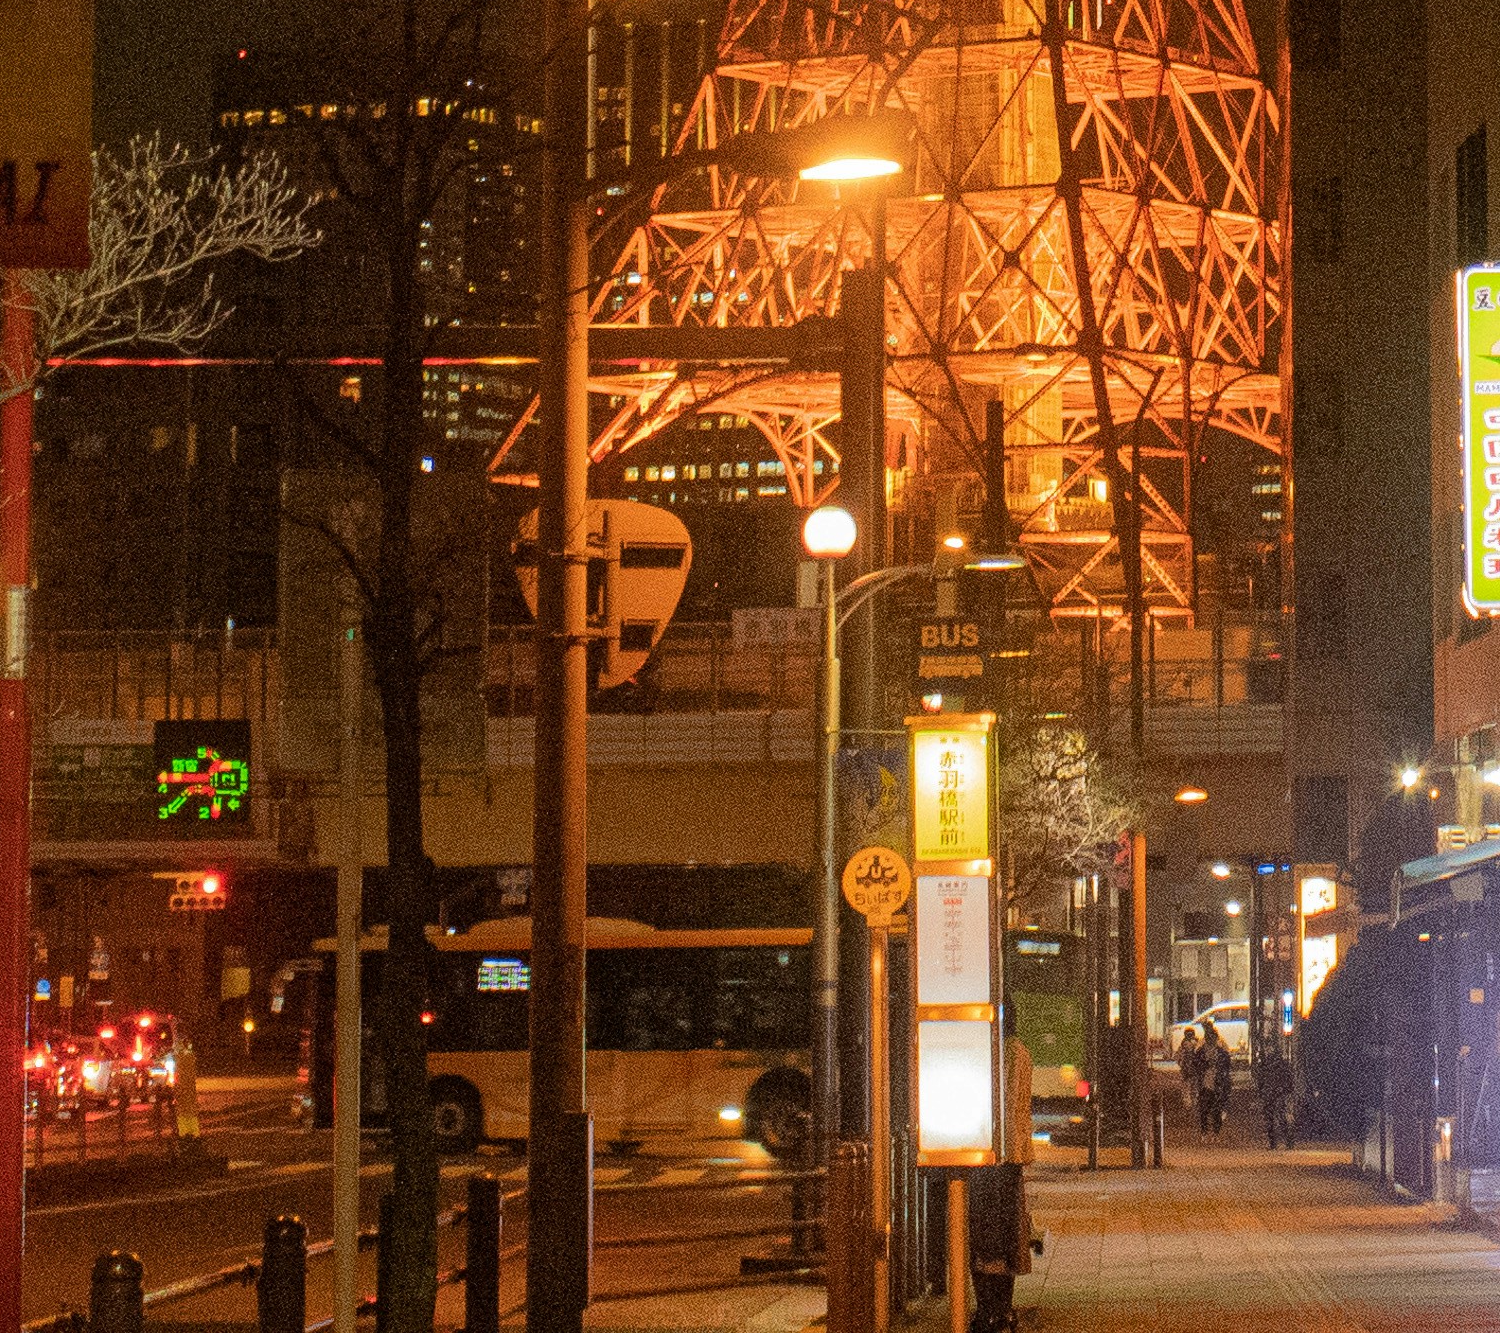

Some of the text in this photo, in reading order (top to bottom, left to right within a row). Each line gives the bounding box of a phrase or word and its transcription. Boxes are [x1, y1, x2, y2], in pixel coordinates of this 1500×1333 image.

[920, 622, 980, 649] BUS
[938, 750, 959, 846] 赤羽橋駅前
[158, 807, 169, 820] 3
[198, 806, 210, 819] 2
[854, 889, 902, 906] ちいばす
